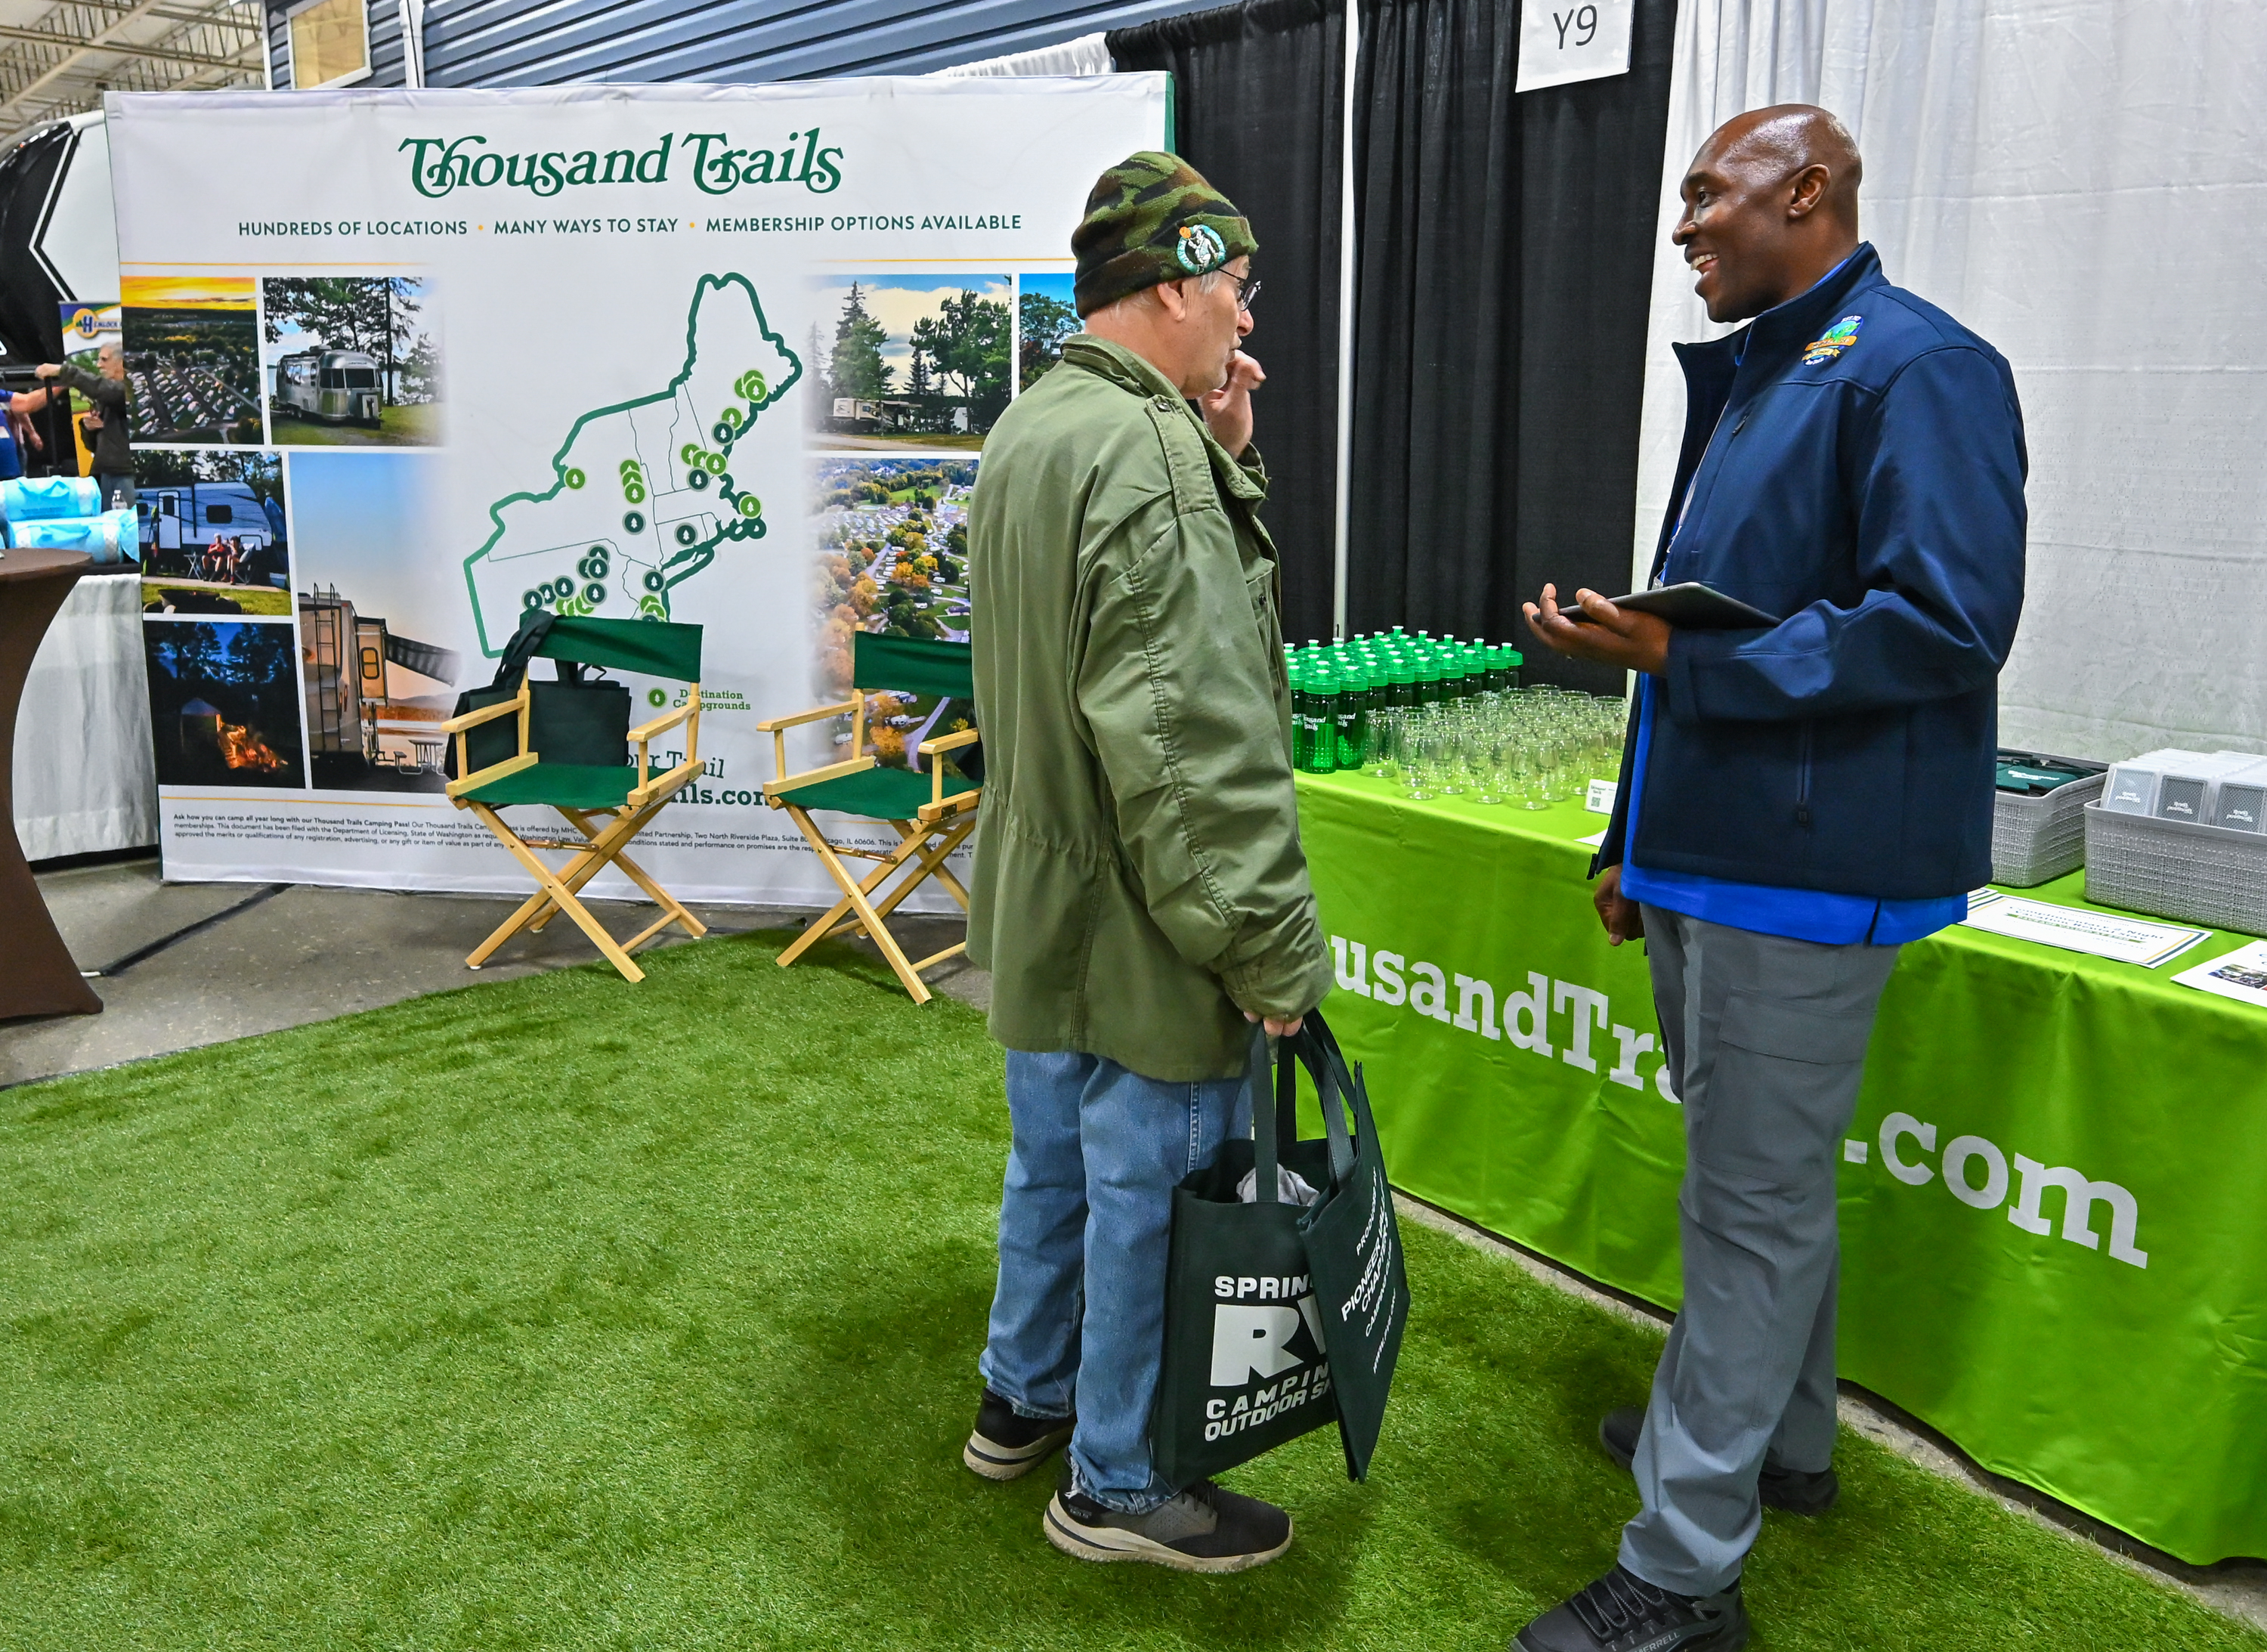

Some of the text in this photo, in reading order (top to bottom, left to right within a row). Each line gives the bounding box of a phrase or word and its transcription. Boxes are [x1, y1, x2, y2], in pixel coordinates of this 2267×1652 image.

[1553, 5, 1597, 49] Y9
[397, 127, 844, 198] Thousand Trails
[238, 215, 1022, 236] HUNDREDS OF LOCATIONS MANY WAYS TO STAY MEMBERSHIP OPTIONS AVAILABLE
[673, 699, 751, 711] Capgrounds
[344, 837, 379, 845] advertising,
[401, 838, 412, 846] gift
[379, 829, 409, 837] Licensing,
[436, 831, 472, 839] Washington
[552, 825, 559, 834] by
[654, 831, 693, 840] Partnership,
[730, 833, 759, 841] Riverside
[761, 834, 781, 842] Plaza,
[1214, 1273, 1313, 1299] SPRIN
[1341, 1236, 1380, 1322] PIONEER
[1207, 1362, 1328, 1419] CAMPIN
[1205, 1389, 1307, 1442] OUTDOOR
